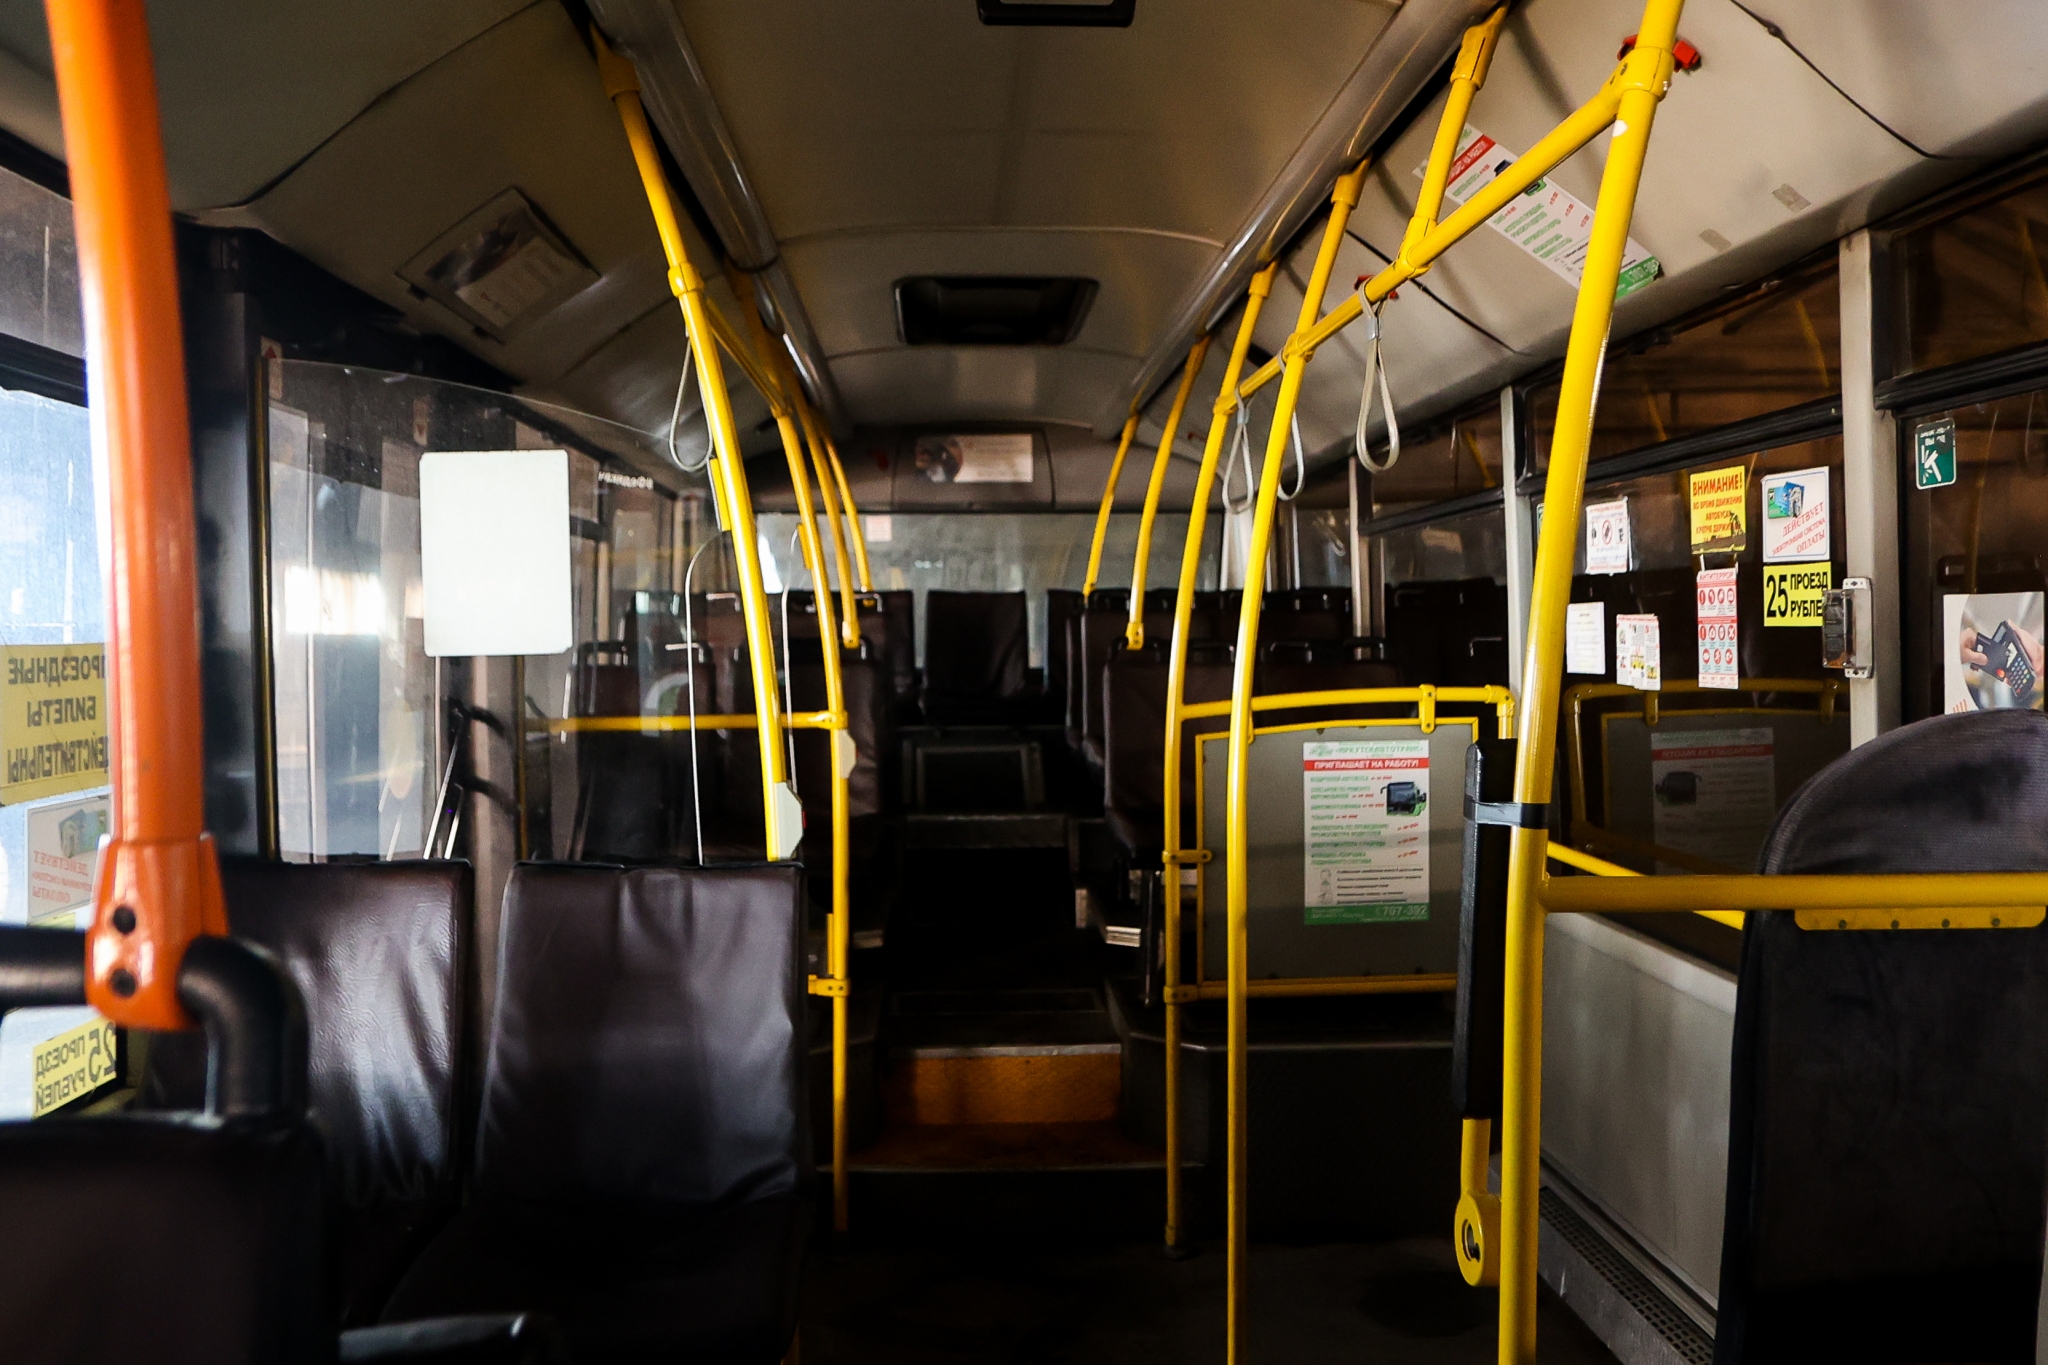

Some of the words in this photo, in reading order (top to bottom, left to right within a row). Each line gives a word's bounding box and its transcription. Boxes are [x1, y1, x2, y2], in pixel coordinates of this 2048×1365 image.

[1692, 472, 1743, 497] ВНИМАНИЕ!
[1782, 501, 1825, 537] ДЕЙСТВУЕТ
[1803, 518, 1826, 537] СИСТЕМА
[1796, 529, 1826, 554] ОПЛАТЫ
[1766, 574, 1788, 618] 25
[1790, 571, 1829, 593] ПРОЕЗД
[1790, 599, 1823, 618] РУБЛЕ
[1314, 760, 1370, 770] ПРИГЛАШАЕТ
[1371, 760, 1384, 769] НА
[1384, 759, 1419, 769] РАБОТУ!
